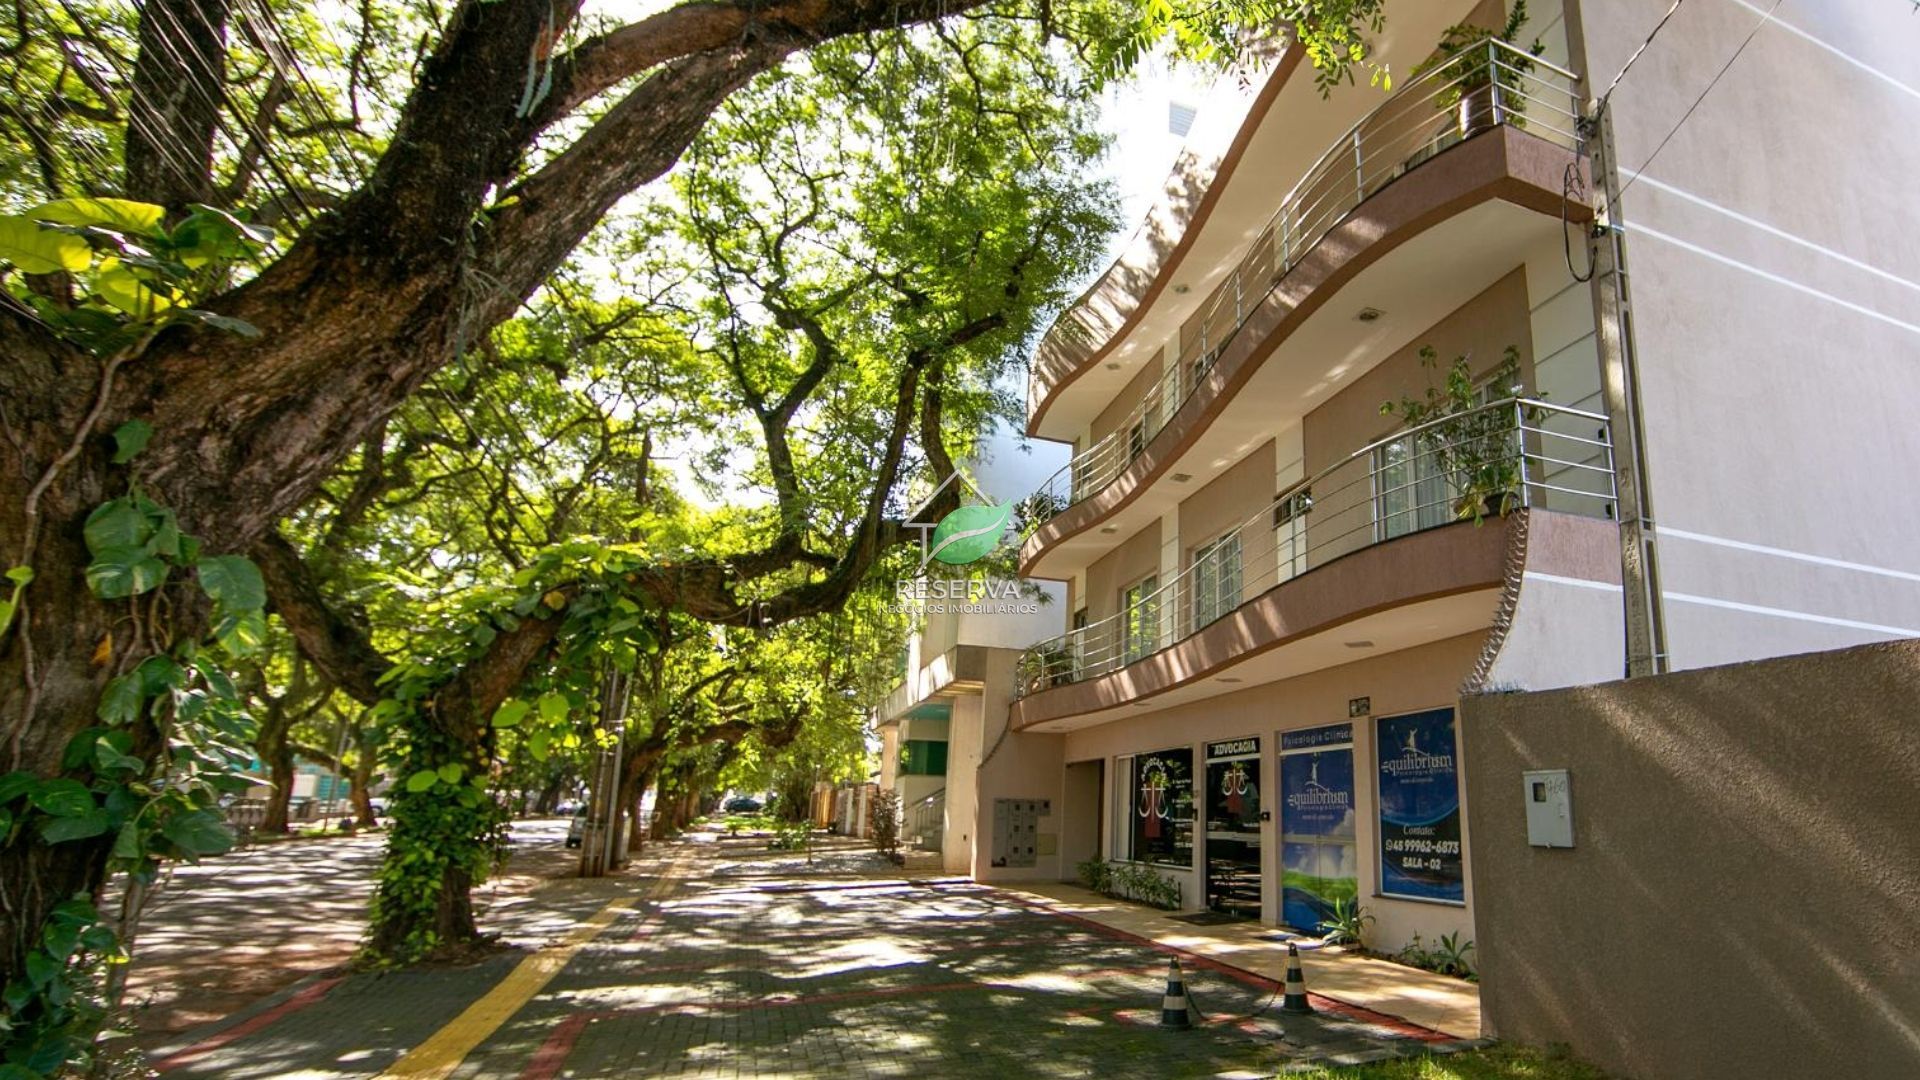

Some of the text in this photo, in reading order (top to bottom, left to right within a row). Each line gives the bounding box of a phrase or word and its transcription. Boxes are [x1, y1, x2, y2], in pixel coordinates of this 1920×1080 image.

[1214, 740, 1256, 755] ADVOCACIA
[1393, 840, 1459, 855] 45 99962-6873
[1402, 857, 1423, 869] SALA
[1430, 859, 1442, 870] 02
